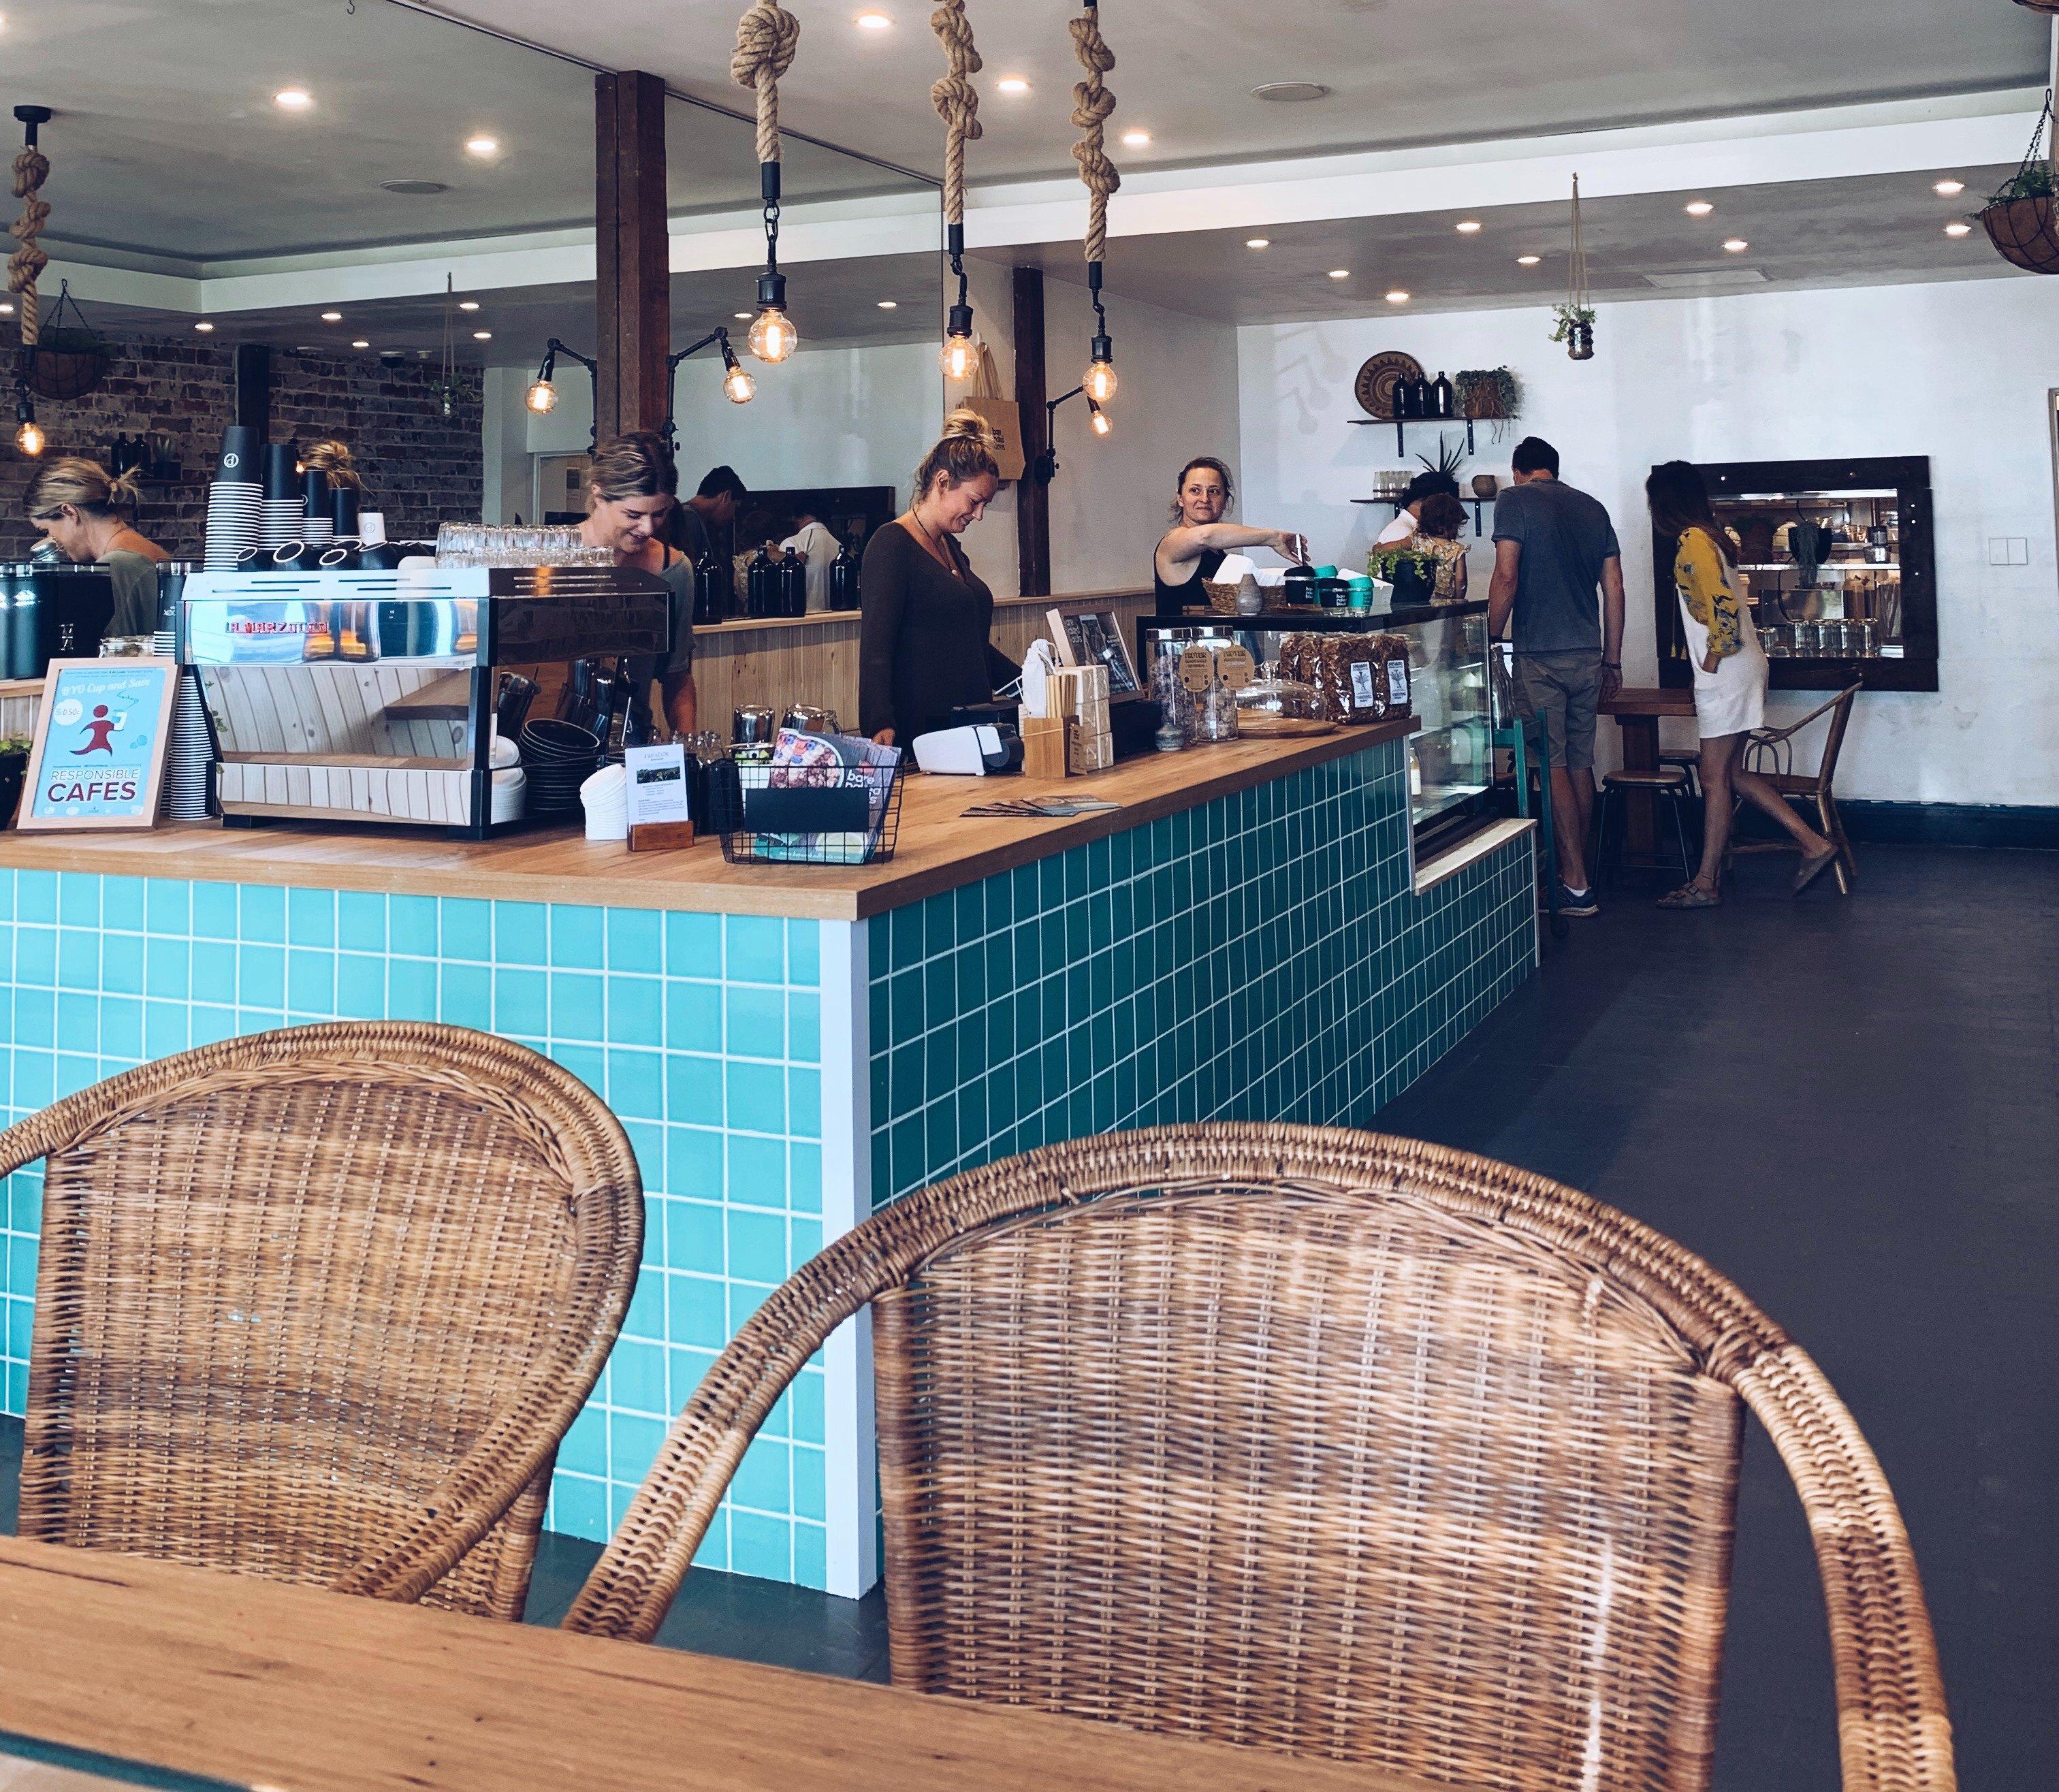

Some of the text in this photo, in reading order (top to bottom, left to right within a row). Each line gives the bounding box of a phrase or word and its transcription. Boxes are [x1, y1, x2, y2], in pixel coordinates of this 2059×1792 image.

[51, 769, 139, 781] RESPONSIBLE
[846, 769, 875, 785] bare
[48, 781, 136, 802] CAFES
